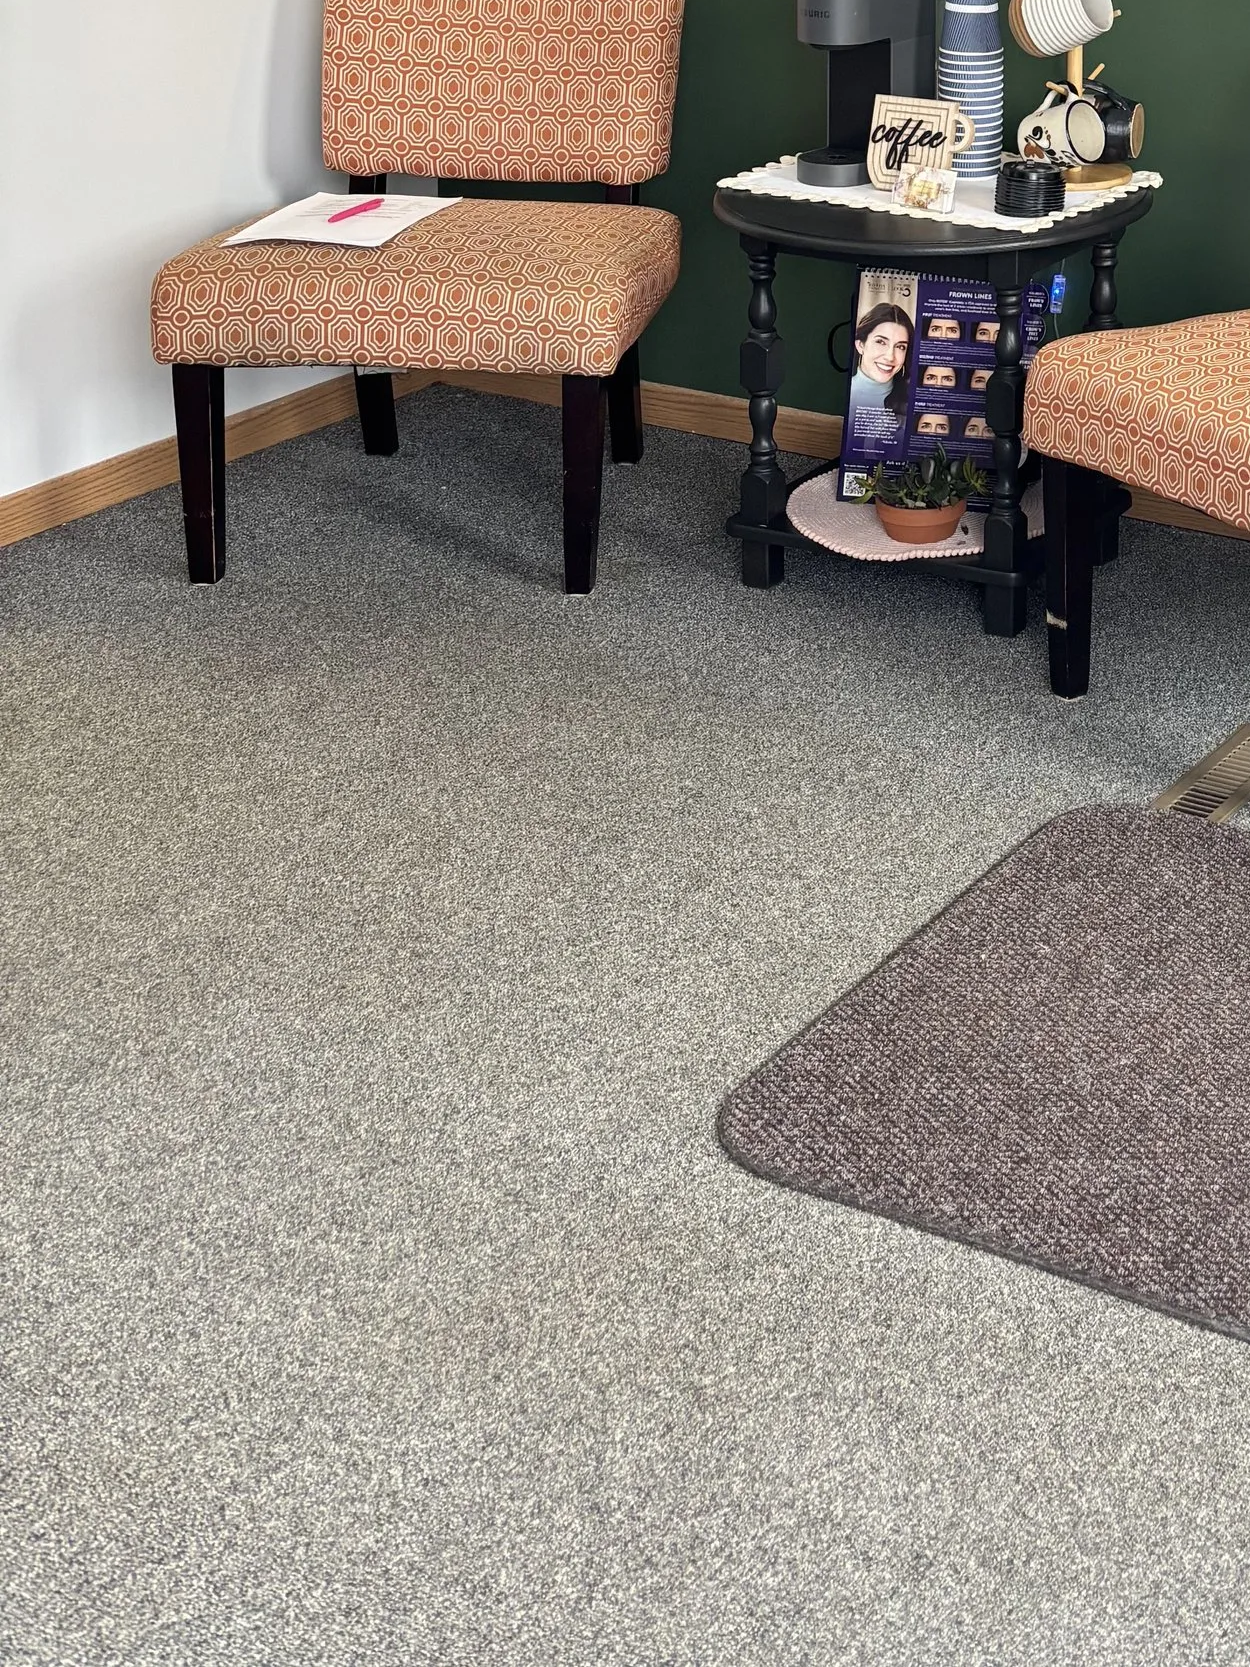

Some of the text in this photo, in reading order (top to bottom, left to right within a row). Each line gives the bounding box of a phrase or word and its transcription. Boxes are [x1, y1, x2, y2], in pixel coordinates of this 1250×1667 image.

[871, 117, 948, 171] coffee
[948, 290, 992, 300] FROWN LINES
